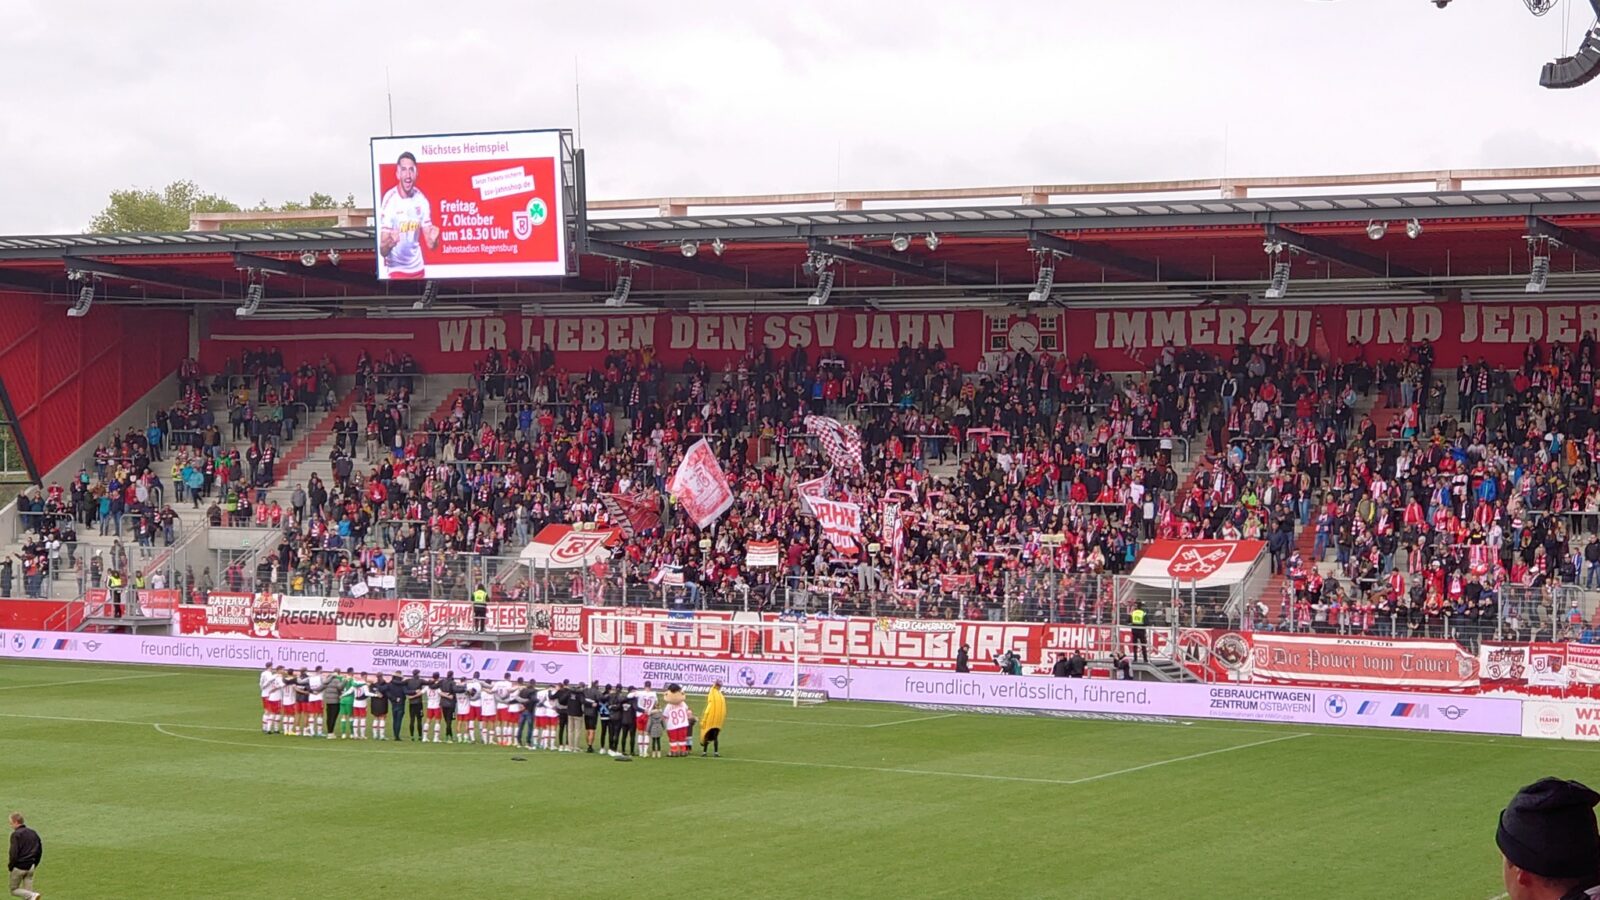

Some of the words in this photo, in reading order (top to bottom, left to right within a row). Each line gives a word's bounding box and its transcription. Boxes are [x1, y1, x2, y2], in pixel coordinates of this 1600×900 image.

[421, 144, 461, 155] Nächstes
[463, 141, 509, 156] Heimspiel
[440, 200, 478, 214] Freitag,
[441, 215, 452, 226] 7.
[453, 214, 494, 226] Oktober
[442, 231, 458, 241] um
[460, 229, 489, 241] 18.30
[491, 228, 509, 240] Uhr
[442, 244, 479, 254] Jahnstadion
[480, 244, 518, 255] Regensburg
[438, 319, 507, 352] WIR
[521, 316, 656, 352] LIEBEN
[670, 315, 747, 350] DEN
[763, 313, 839, 349] SSV
[852, 313, 955, 349] JAHN
[1094, 308, 1312, 348] IMMERZU
[1345, 305, 1443, 344] UND
[321, 599, 355, 608] Fanclub
[281, 609, 376, 628] REGENSBURG
[378, 612, 395, 628] 81
[553, 614, 580, 631] 1889
[594, 612, 723, 649] ULTRAS
[771, 618, 1029, 665] REGENSBURG
[1047, 627, 1096, 649] JAHN
[1337, 639, 1393, 647] FANCLUB
[141, 641, 203, 660] freundlich,
[206, 643, 273, 661] verlässlich,
[278, 646, 329, 664] führend.
[372, 648, 448, 660] GEBRAUCHTWAGEN
[372, 658, 409, 667] ZENTRUM
[409, 660, 448, 670] OSTBAYERN
[1273, 648, 1300, 665] Die
[1306, 648, 1358, 670] Power
[1363, 653, 1394, 671] vom
[1401, 653, 1451, 672] Tower
[643, 662, 726, 674] GEBRAUCHTWAGEN
[643, 671, 683, 681] ZENTRUM
[683, 673, 726, 684] OSTBAYERN
[679, 683, 711, 693] allmeie
[719, 687, 768, 696] PANOMERA
[905, 677, 985, 699] freundlich,
[990, 683, 1078, 704] verlässlich,
[1083, 686, 1151, 705] führend.
[1210, 688, 1311, 702] GEBRAUCHTWAGEN
[643, 698, 652, 709] 19
[1210, 699, 1258, 711] ZENTRUM
[1259, 701, 1311, 713] OSTBAYERN
[671, 708, 685, 726] 89
[1575, 723, 1600, 736] NA
